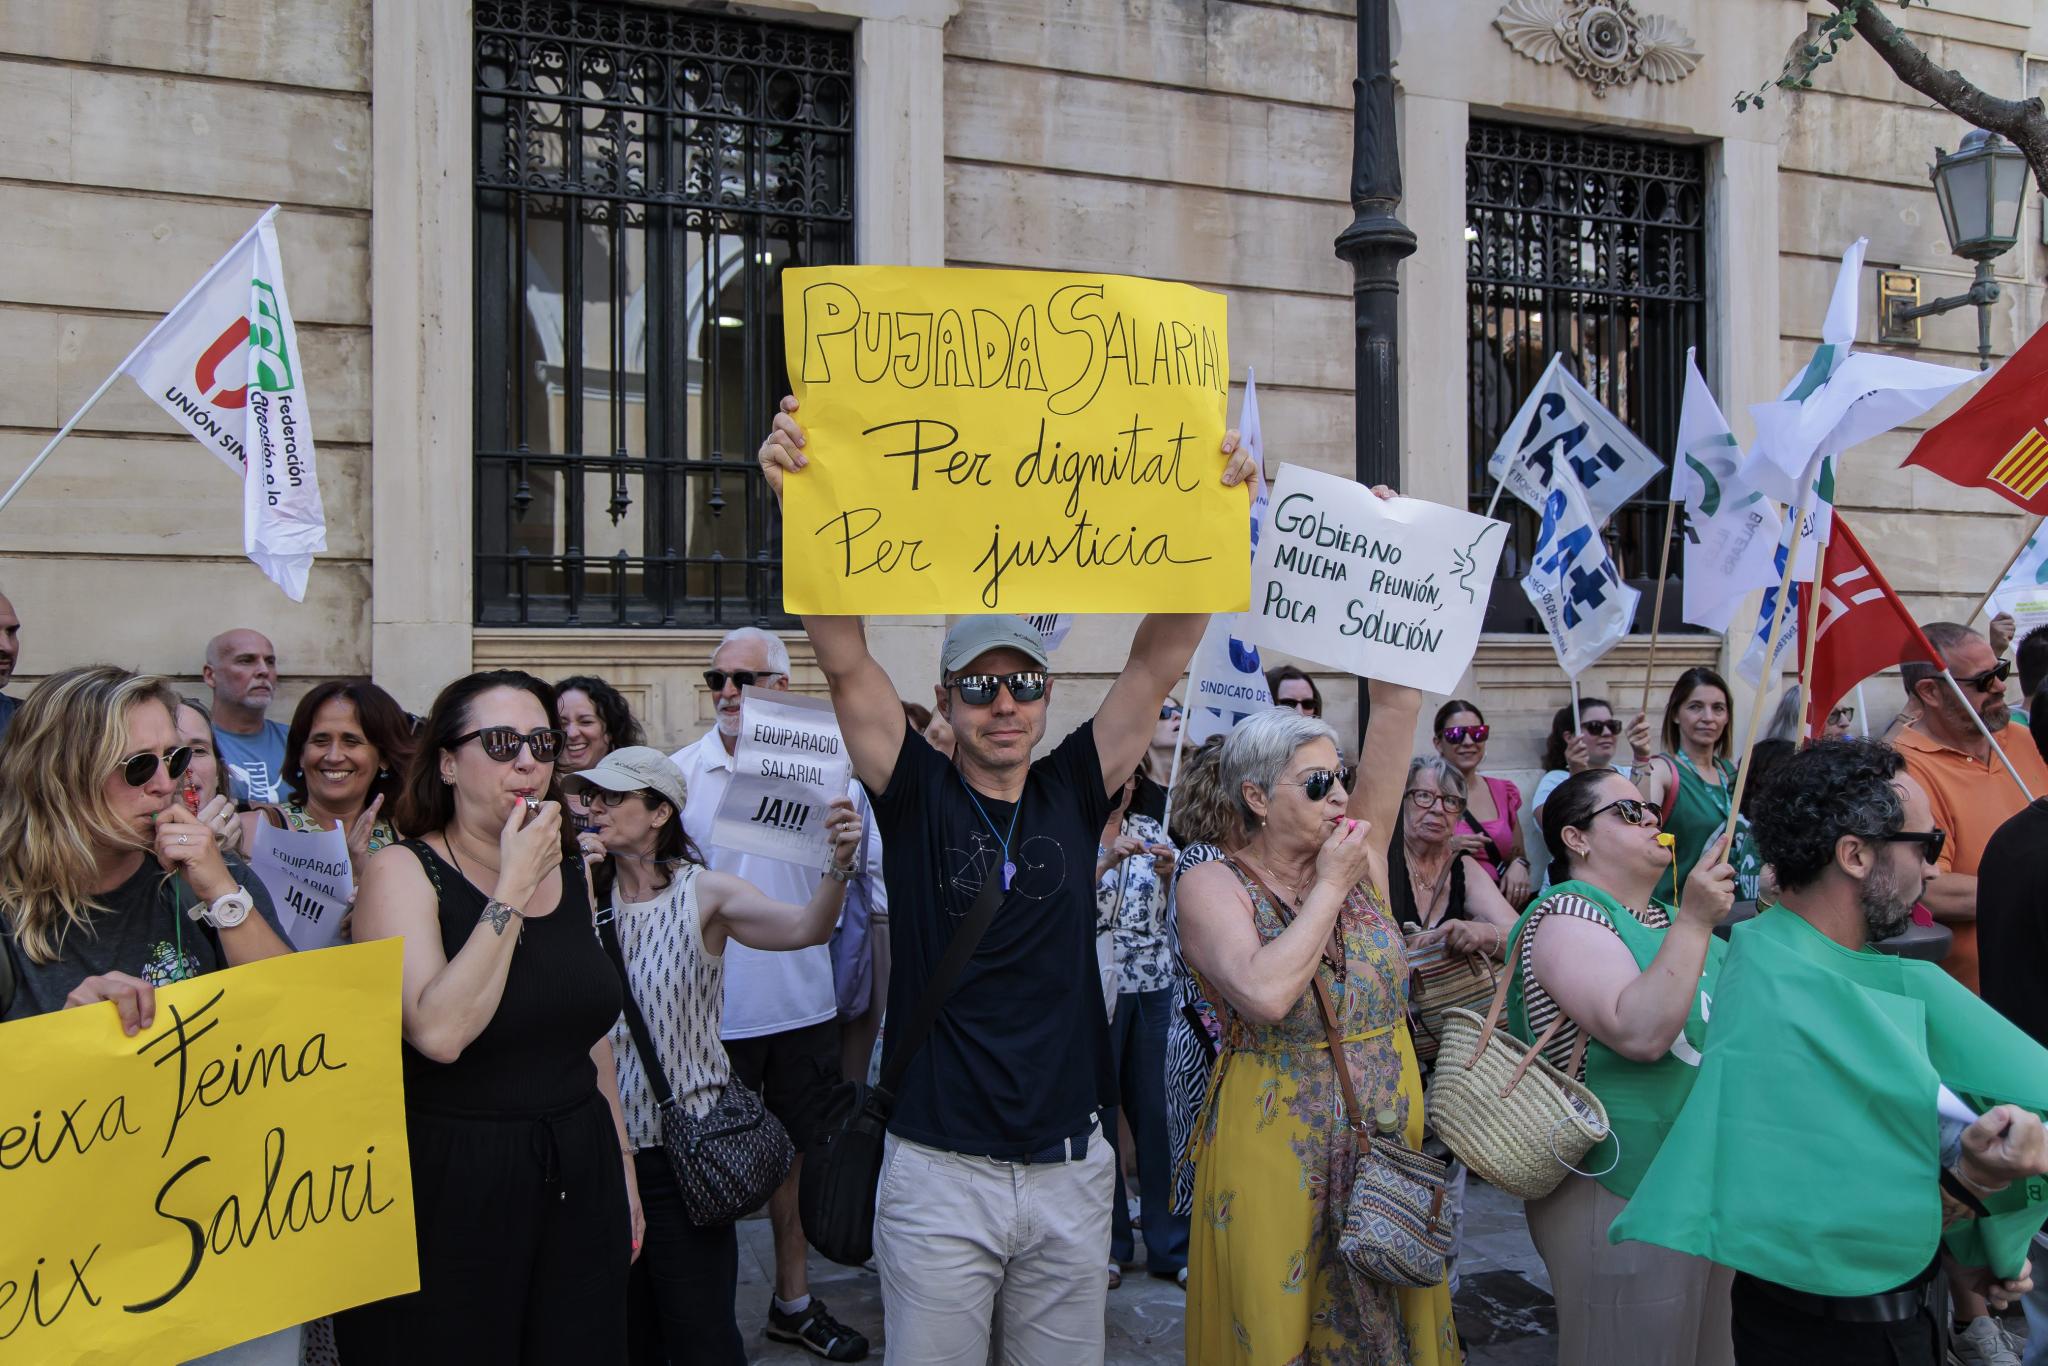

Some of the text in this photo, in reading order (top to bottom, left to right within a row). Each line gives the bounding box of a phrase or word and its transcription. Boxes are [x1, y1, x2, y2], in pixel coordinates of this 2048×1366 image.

[802, 282, 1048, 392] PUJADA
[165, 386, 222, 437] UNIÓN
[219, 434, 248, 465] SIN
[278, 395, 306, 487] Federación
[862, 413, 1200, 517] Per dignitat
[268, 490, 281, 506] la
[816, 508, 1212, 608] Per justicia
[1274, 545, 1347, 582] MUCHA
[1262, 580, 1316, 624] POCA
[1200, 680, 1254, 700] SINDICATO
[1256, 690, 1266, 702] DE
[754, 724, 840, 755] EQUIPARACIÓ
[761, 759, 825, 786] SALARIAL
[751, 796, 811, 832] JA!!!
[284, 885, 325, 924] JA!!!
[137, 988, 348, 1159] Feina
[123, 1127, 395, 1314] Salari
